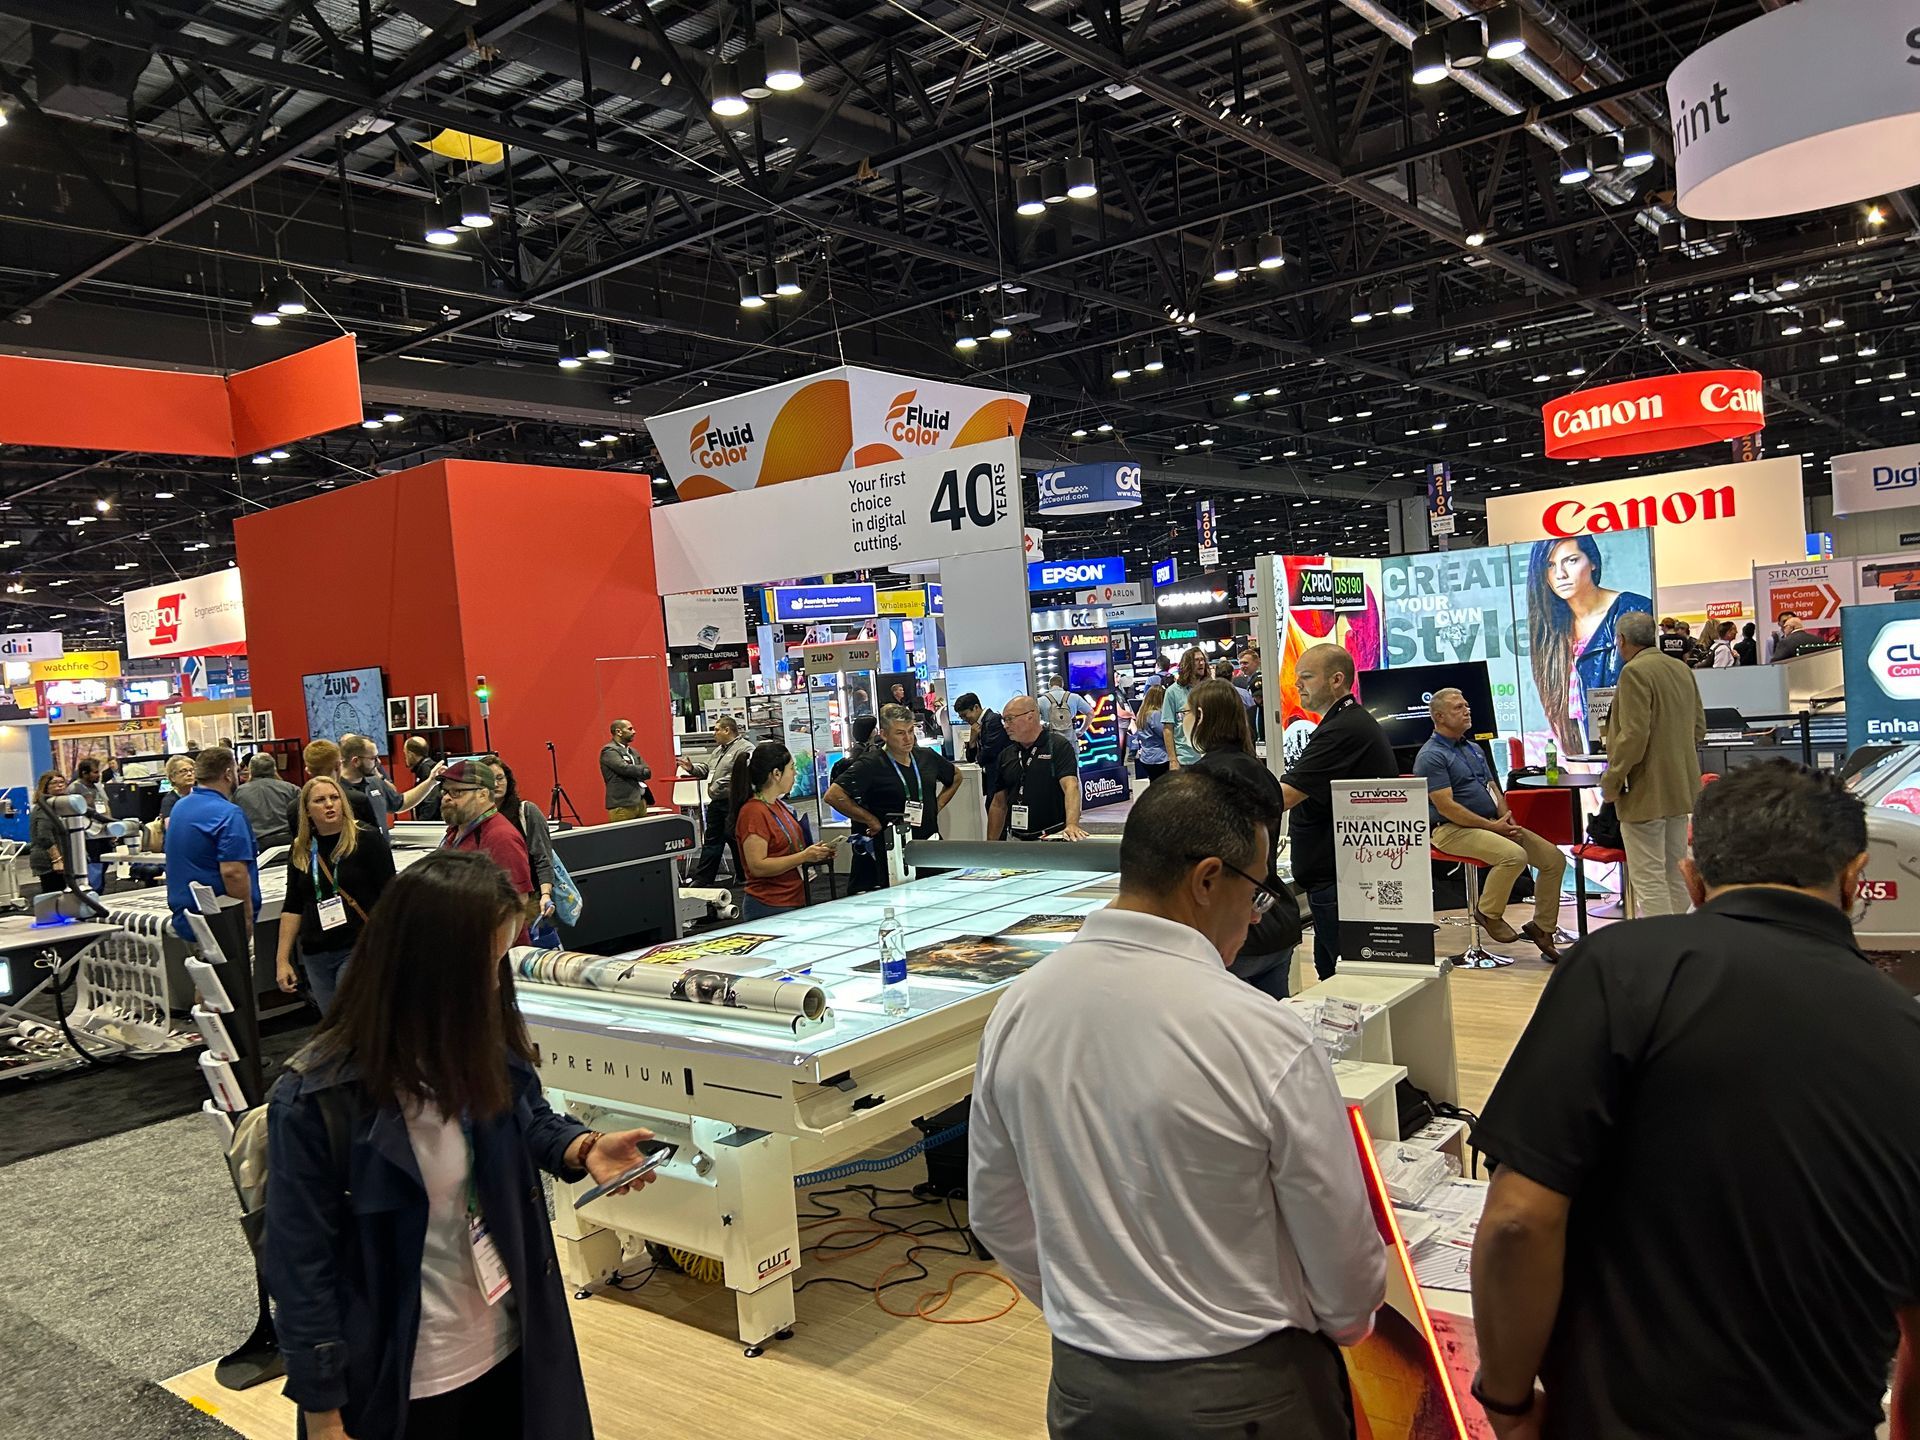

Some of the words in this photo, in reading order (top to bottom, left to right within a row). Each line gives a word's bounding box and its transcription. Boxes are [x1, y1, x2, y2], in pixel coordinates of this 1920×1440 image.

[1674, 81, 1730, 157] rint
[906, 404, 949, 431] Fluid
[1553, 394, 1663, 438] Canon
[707, 422, 755, 451] Fluid
[892, 421, 940, 446] Color
[700, 447, 748, 470] Color
[849, 478, 876, 495] Your
[880, 472, 906, 488] first
[994, 462, 1008, 521] YEARS
[850, 495, 892, 512] choice
[929, 462, 997, 532] 40
[1435, 476, 1446, 515] 2100
[852, 518, 863, 533] in
[866, 510, 907, 532] digital
[1542, 485, 1736, 538] Canon
[1203, 512, 1212, 547] 2000
[853, 535, 902, 553] cutting.
[1042, 565, 1103, 584] EPSON
[1301, 571, 1332, 594] XPRO
[1383, 554, 1529, 599] CREATE
[1769, 566, 1828, 579] STRATOJET
[1112, 589, 1135, 597] ARLON
[1334, 576, 1362, 594] DS190
[1792, 590, 1820, 599] Comes
[1396, 596, 1449, 613] YOUR
[1707, 602, 1740, 611] Revenue
[130, 606, 182, 633] ORAFOL
[1071, 612, 1092, 628] GCC
[1435, 607, 1482, 626] OWN
[1072, 634, 1108, 645] Allanson
[1167, 630, 1197, 639] Allanson
[44, 662, 89, 672] watchfire
[1085, 778, 1123, 801] Skyline
[1350, 788, 1406, 798] CUTWORX
[1336, 820, 1427, 834] FINANCING
[1342, 834, 1423, 847] AVAILABLE
[552, 1052, 673, 1086] PREMIUM
